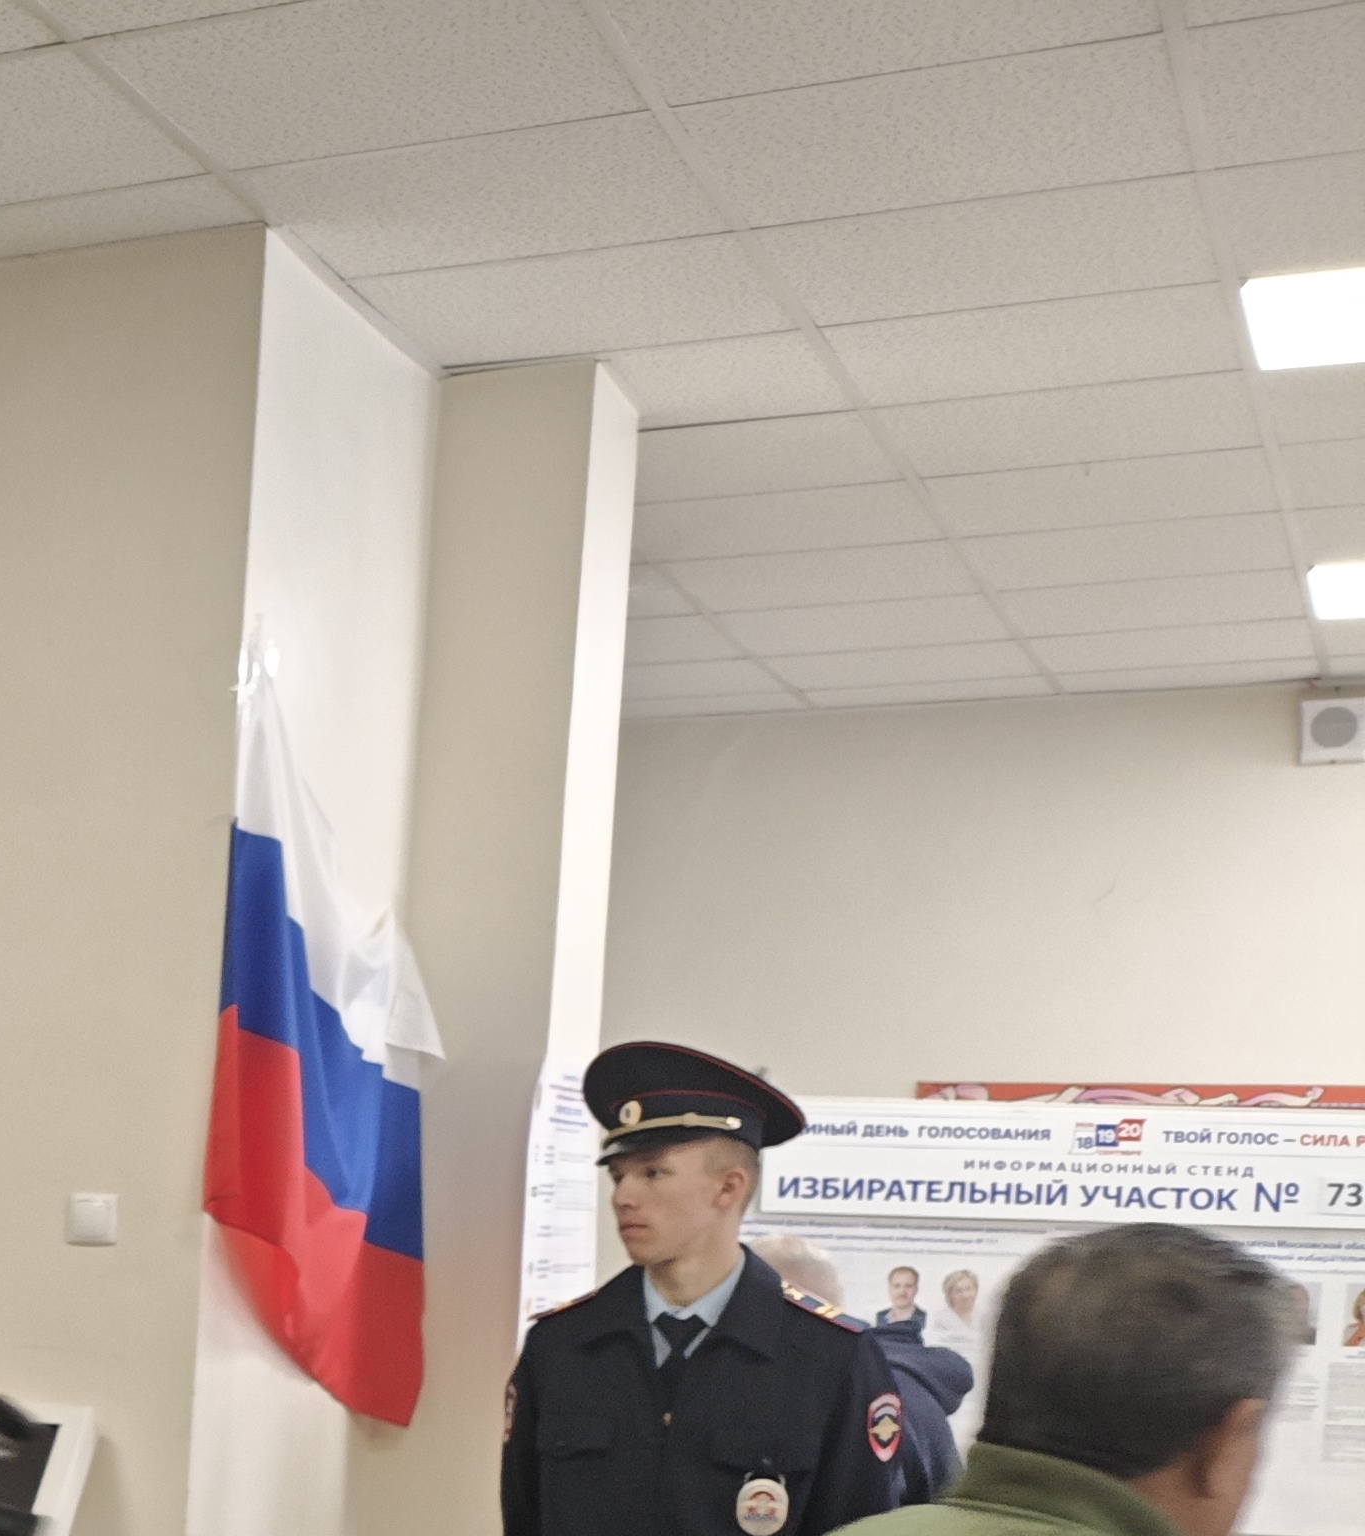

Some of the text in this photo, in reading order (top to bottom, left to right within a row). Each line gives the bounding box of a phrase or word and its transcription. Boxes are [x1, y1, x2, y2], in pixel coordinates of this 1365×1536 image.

[804, 1120, 1052, 1141] ИНЫЙ ДЕНЬ ГОЛОСОВАНИЯ
[1097, 1128, 1116, 1144] 19
[1118, 1122, 1141, 1138] 20
[1162, 1128, 1212, 1144] ТВОЙ
[1218, 1131, 1279, 1146] ГОЛОС
[1299, 1133, 1351, 1147] СИЛА
[963, 1159, 1255, 1178] ИНФОРМАЦИОННЫЙ СТЕНД
[778, 1176, 1363, 1213] ИЗБИРАТЕЛЬНЫЙ УЧАСТОК № 73
